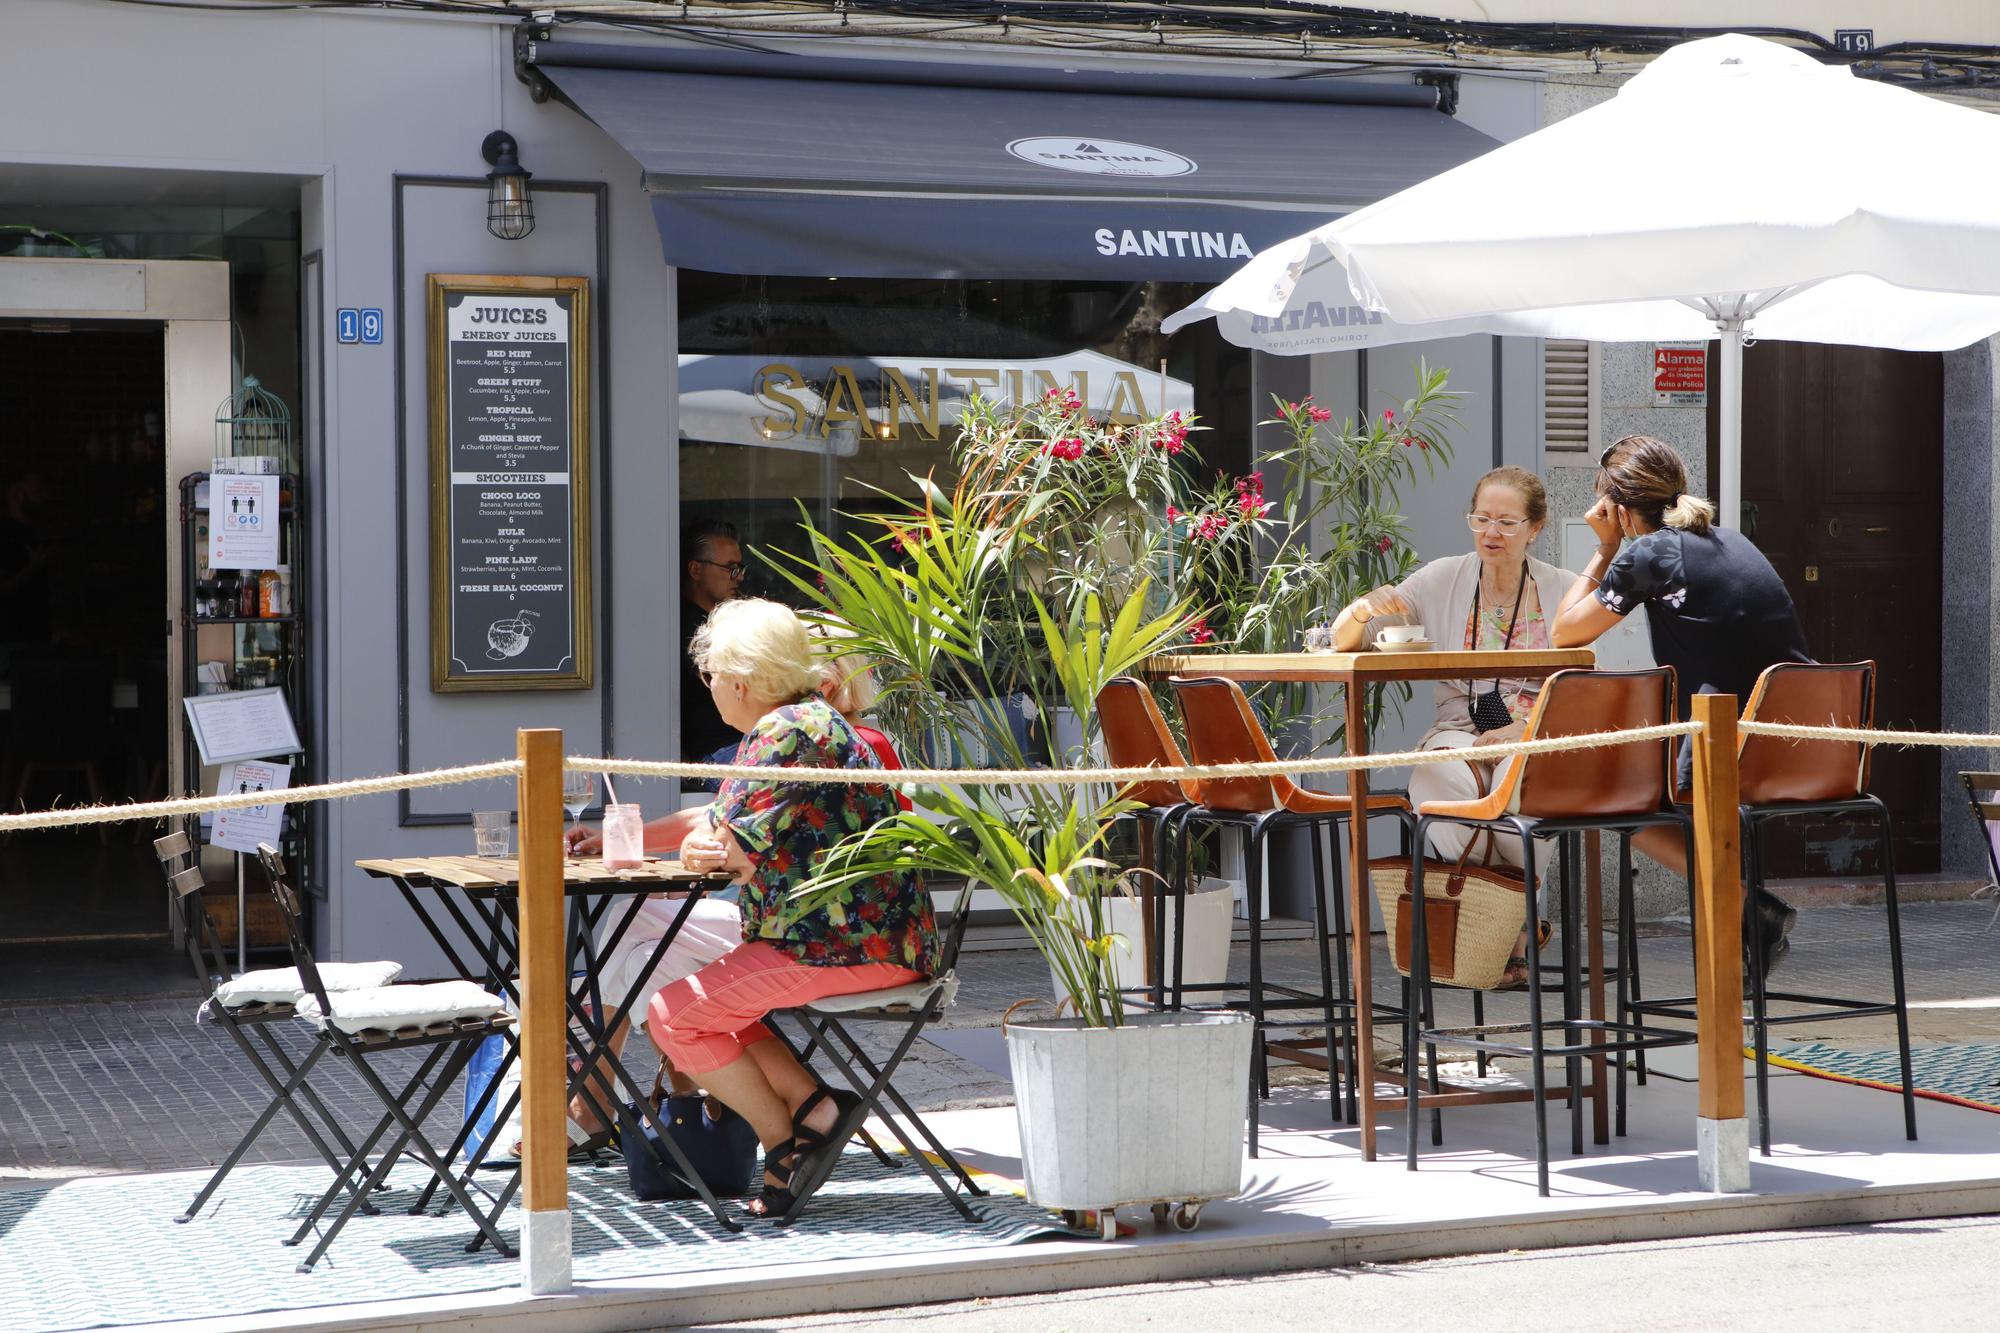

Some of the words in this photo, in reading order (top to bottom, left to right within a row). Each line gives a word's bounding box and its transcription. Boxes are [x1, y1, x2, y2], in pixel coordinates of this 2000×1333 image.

[1843, 34, 1869, 51] 19
[1038, 152, 1163, 163] SANTINA
[1094, 228, 1255, 259] SANTINA
[470, 307, 548, 324] JUICES
[343, 315, 378, 337] 19
[461, 331, 510, 341] ENERGY
[513, 332, 557, 341] JUICES
[486, 350, 506, 358] RED
[508, 350, 532, 358] MIST
[1656, 352, 1704, 365] Alarma
[484, 359, 502, 367] Apple,
[502, 359, 521, 367] Ginger,
[523, 359, 542, 367] Lemon,
[503, 366, 516, 374] 5.5
[477, 378, 509, 386] GREEN
[511, 378, 542, 386] STUFF
[468, 387, 499, 395] Cucumber,
[499, 387, 513, 395] Kiwi,
[513, 388, 532, 396] Apple,
[532, 388, 551, 396] Celery
[503, 394, 516, 402] 5.5
[751, 363, 1153, 441] SANTINA
[486, 406, 534, 414] TROPICAL
[468, 415, 489, 423] Lemon,
[489, 416, 508, 424] Apple,
[508, 416, 538, 424] Pineapple,
[504, 422, 517, 431] 5.5
[478, 434, 514, 443] GINGER
[516, 434, 542, 443] SHOT
[466, 443, 486, 451] Chunk
[485, 443, 493, 451] of
[493, 443, 514, 452] Ginger,
[514, 444, 538, 452] Cayenne
[539, 444, 560, 453] Pepper
[504, 459, 517, 467] 3.5
[476, 474, 546, 483] SMOOTHIES
[480, 492, 513, 500] CHOCO
[516, 492, 541, 500] LOCO
[480, 501, 503, 509] Banana,
[478, 509, 508, 517] Chocolate,
[508, 516, 514, 524] 6
[497, 528, 526, 536] HULK
[461, 537, 484, 545] Banana,
[484, 537, 498, 545] Kiwi,
[499, 537, 521, 545] Orange,
[521, 537, 547, 545] Avocado,
[508, 544, 515, 552] 6
[485, 556, 509, 564] PINK
[511, 556, 538, 564] LADY
[460, 565, 497, 573] Strawberries,
[498, 565, 521, 573] Banana,
[521, 565, 537, 573] Mint,
[510, 572, 516, 580] 6
[459, 584, 490, 593] FRESH
[492, 585, 518, 593] REAL
[519, 584, 564, 593] COCONUT
[509, 593, 515, 601] 6
